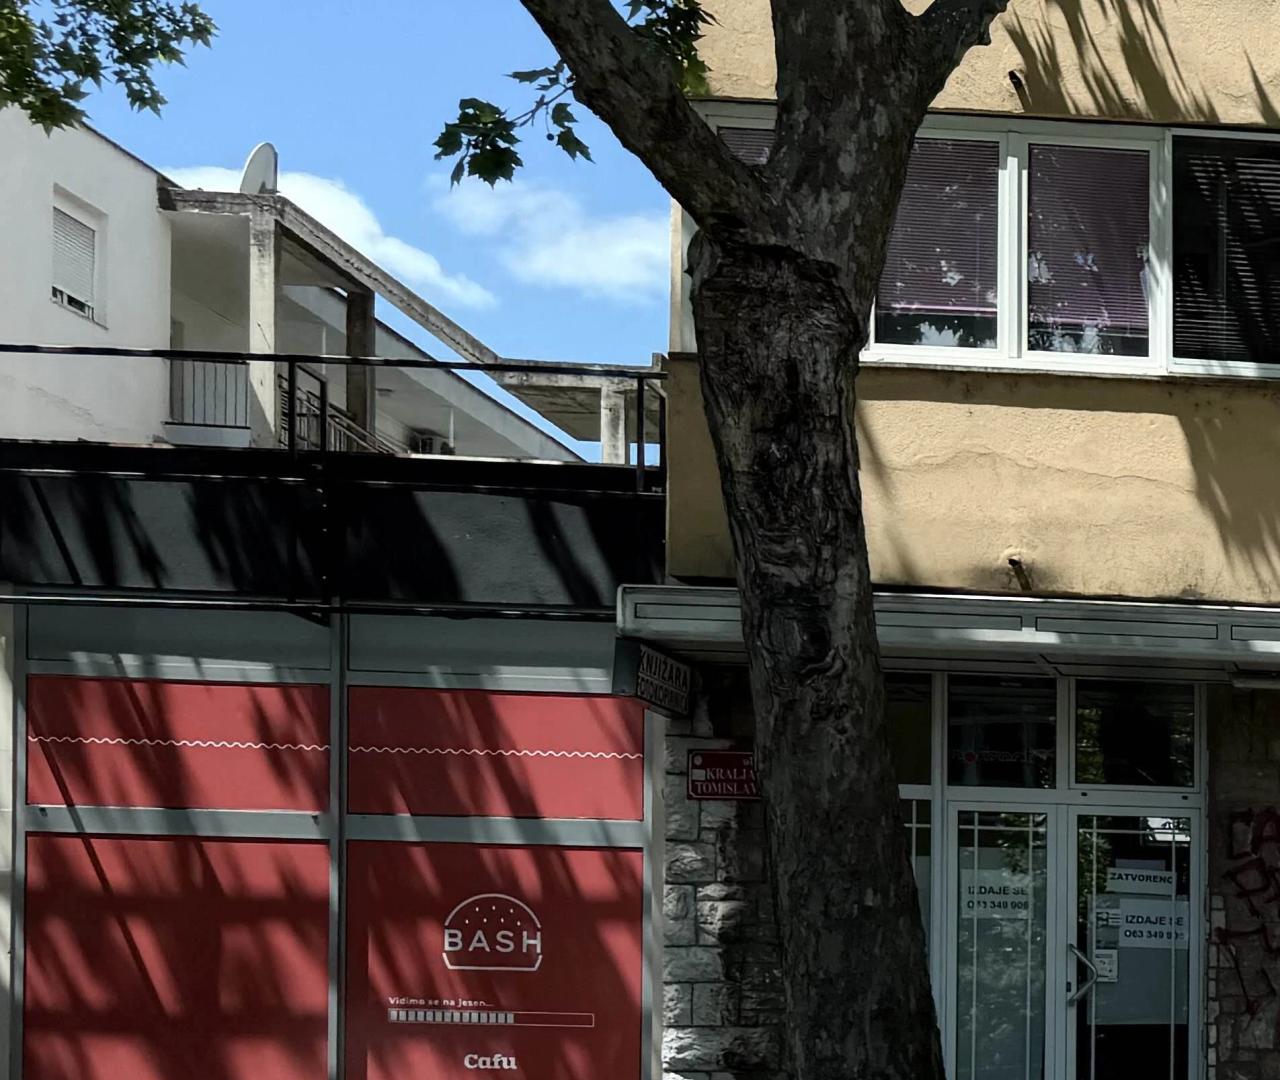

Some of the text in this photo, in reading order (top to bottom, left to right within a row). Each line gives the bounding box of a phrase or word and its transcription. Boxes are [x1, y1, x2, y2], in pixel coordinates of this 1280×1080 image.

[694, 782, 761, 795] TOMISLAV
[1125, 915, 1166, 925] IZDAJE
[443, 928, 542, 954] BASH
[388, 996, 425, 1006] Vidimo
[463, 1053, 518, 1069] Cafu
